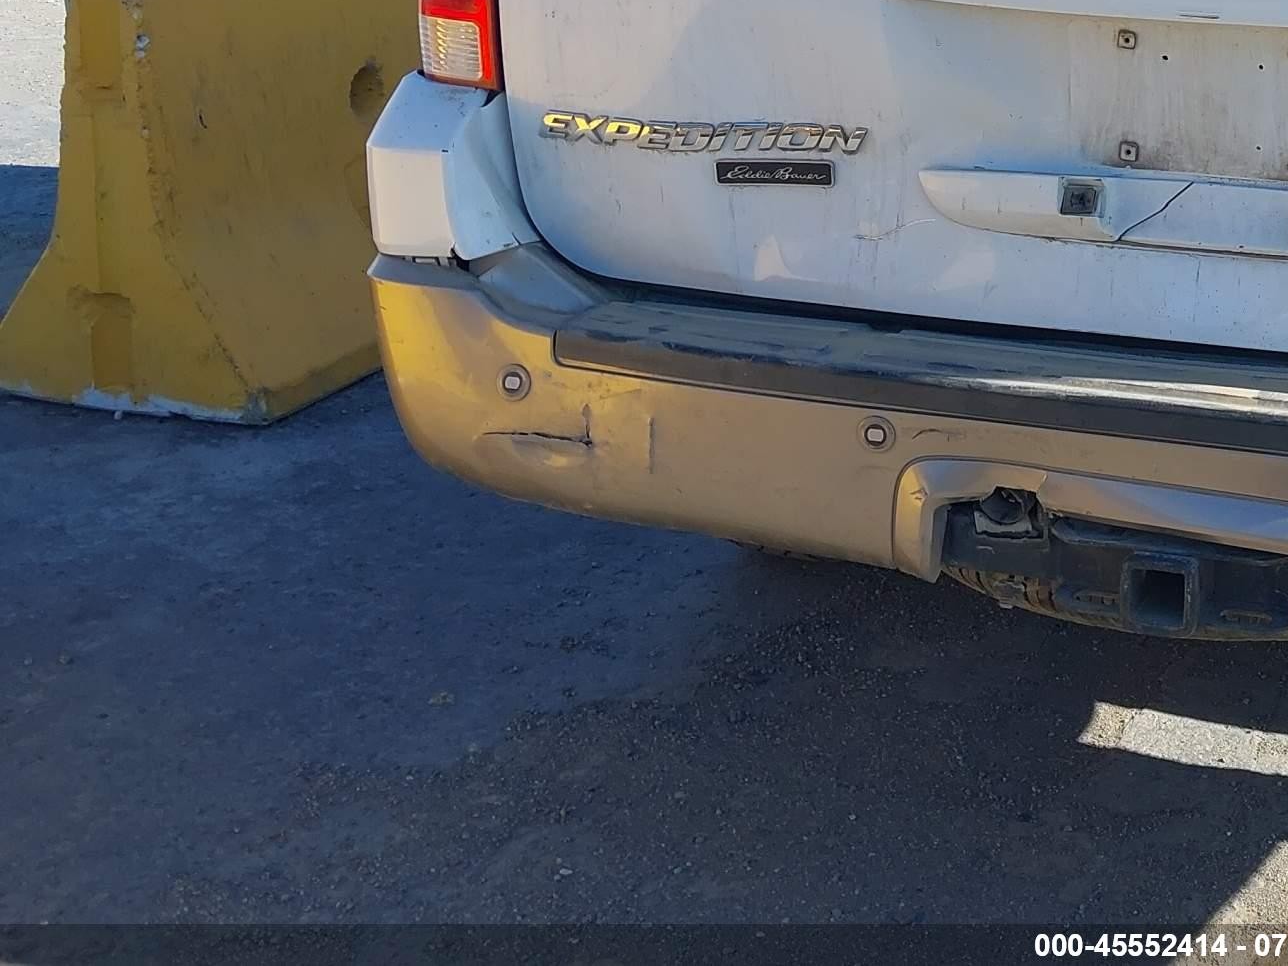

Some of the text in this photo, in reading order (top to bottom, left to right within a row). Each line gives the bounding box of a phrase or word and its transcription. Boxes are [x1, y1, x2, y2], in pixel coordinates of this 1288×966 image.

[543, 109, 869, 155] EXPEDITION
[720, 165, 827, 181] Eddie Bauer
